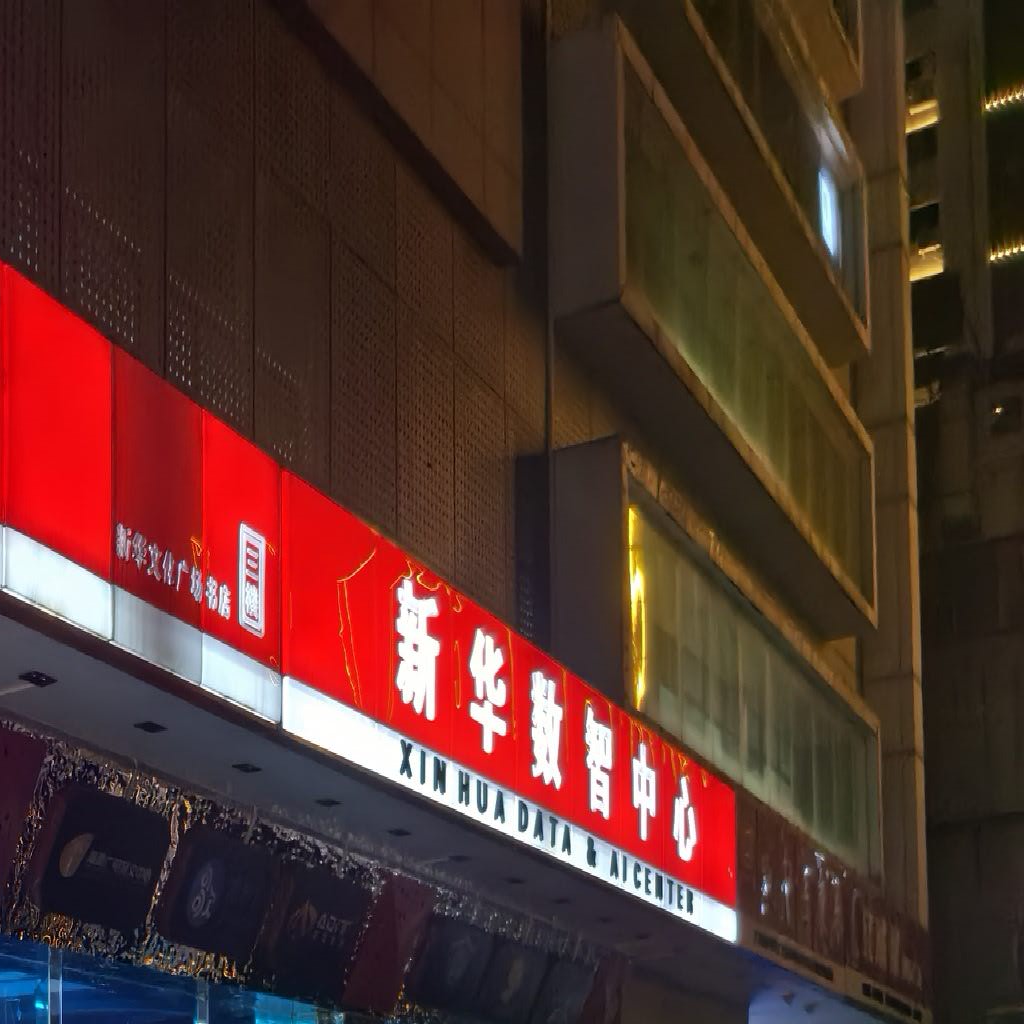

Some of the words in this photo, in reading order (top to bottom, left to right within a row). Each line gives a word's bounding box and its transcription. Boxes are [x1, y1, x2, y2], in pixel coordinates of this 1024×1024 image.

[395, 577, 698, 864] 新华数智中心
[517, 799, 572, 856] DATA
[586, 836, 597, 868] &
